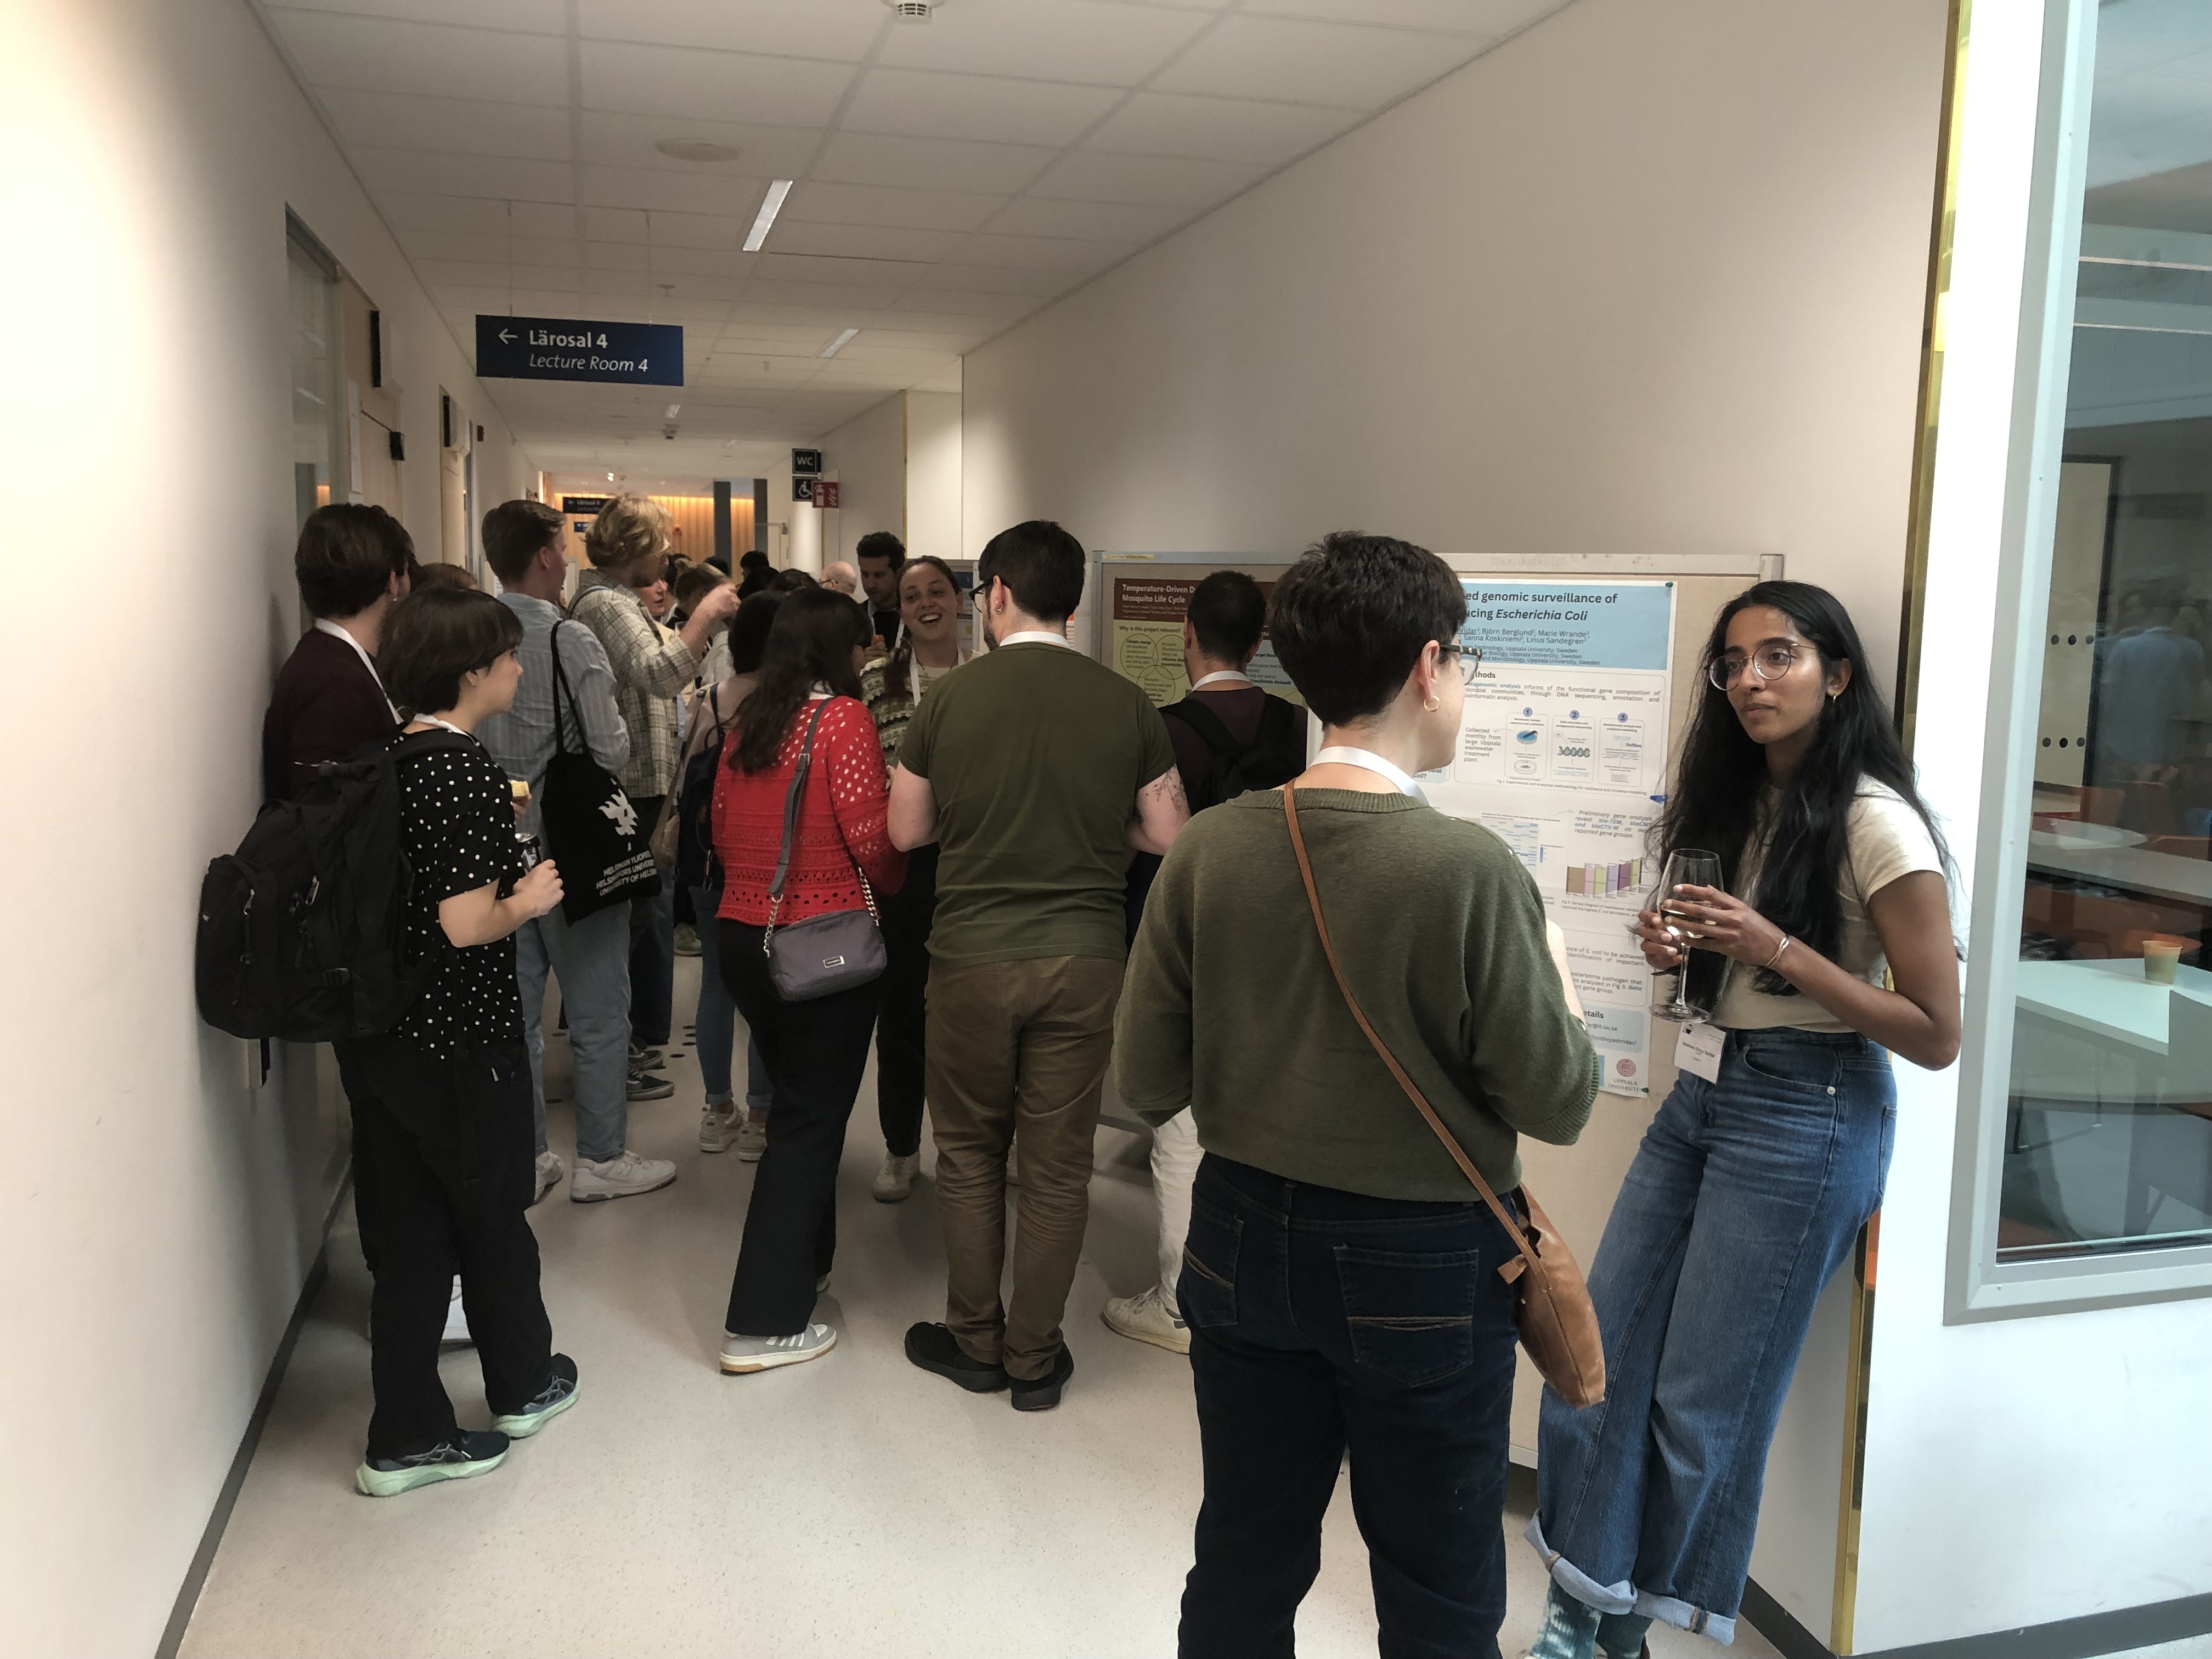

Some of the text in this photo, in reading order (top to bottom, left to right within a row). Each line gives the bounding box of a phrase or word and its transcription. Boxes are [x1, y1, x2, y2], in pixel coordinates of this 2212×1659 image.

[529, 330, 608, 349] Lärosal 4
[529, 353, 648, 373] Lecture Room 4
[796, 456, 814, 466] WC
[1122, 584, 1188, 593] Temperature-Driven
[1122, 594, 1153, 603] Mosquito
[1167, 596, 1186, 605] Cycle
[1465, 591, 1618, 603] ed genomic surveillance of
[1496, 609, 1562, 620] Escherichia
[1564, 610, 1589, 621] Coli
[1482, 628, 1501, 636] Björn
[1578, 810, 1610, 819] Preliminary
[630, 873, 639, 883] OF
[1602, 975, 1629, 984] pathogen
[1583, 1011, 1604, 1019] etails
